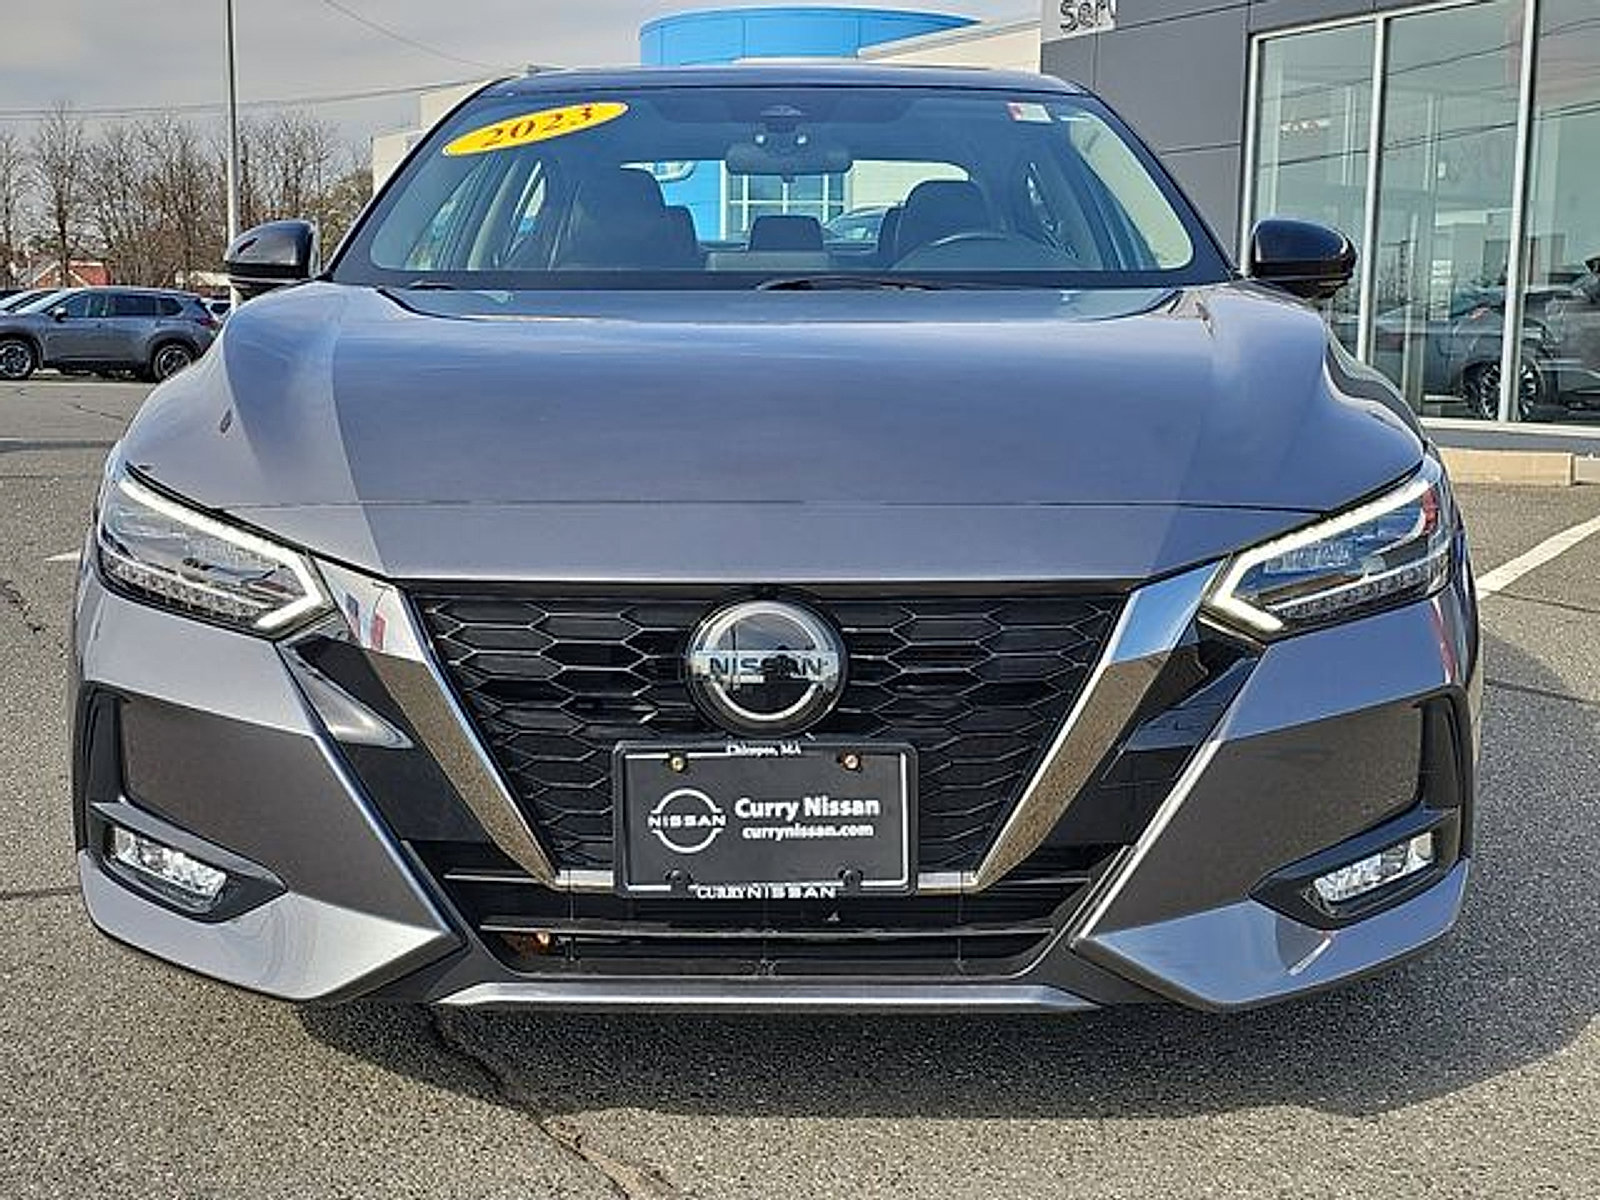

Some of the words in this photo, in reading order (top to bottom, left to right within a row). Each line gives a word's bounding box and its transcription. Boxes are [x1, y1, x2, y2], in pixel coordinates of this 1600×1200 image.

[709, 656, 821, 675] NISSAN
[735, 797, 798, 821] Curry
[803, 795, 881, 817] Nissan
[648, 814, 726, 827] NISSAN
[742, 822, 875, 841] currynissan.com
